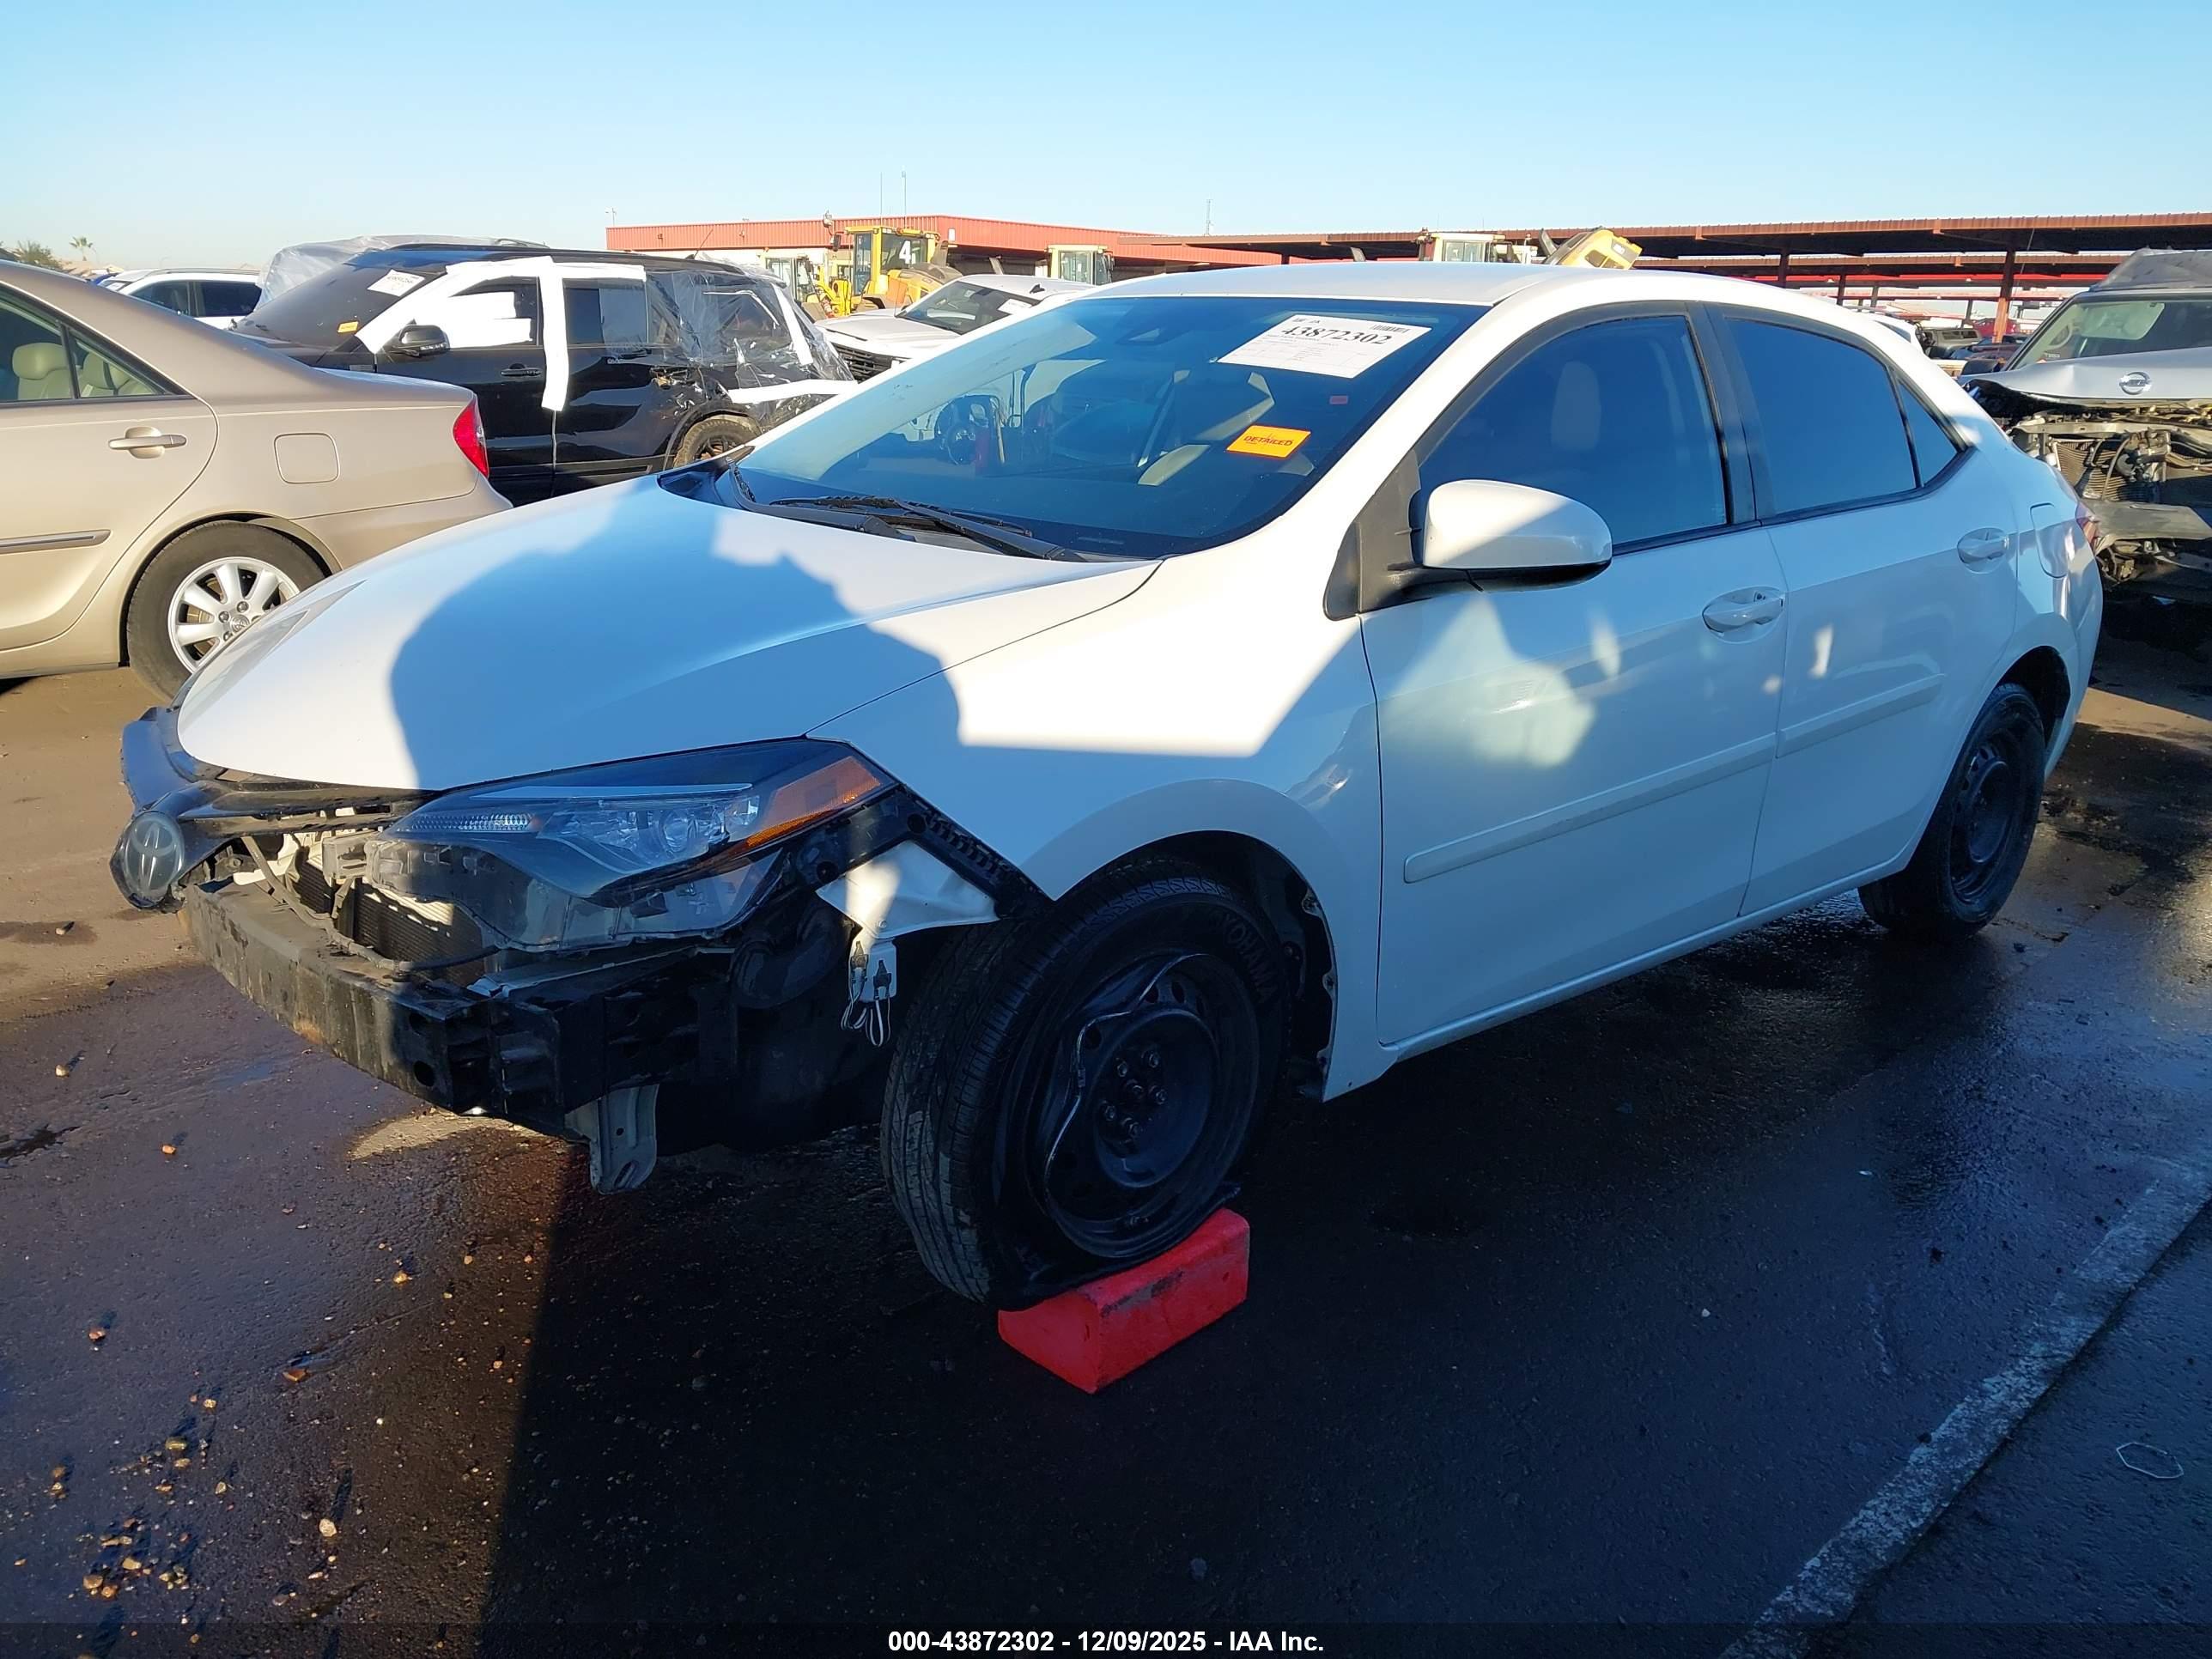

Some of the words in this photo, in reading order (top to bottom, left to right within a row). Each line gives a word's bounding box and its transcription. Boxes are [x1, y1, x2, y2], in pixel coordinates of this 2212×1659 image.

[899, 240, 911, 264] 4
[1281, 326, 1392, 344] 43872302
[1243, 434, 1294, 447] DETAILED
